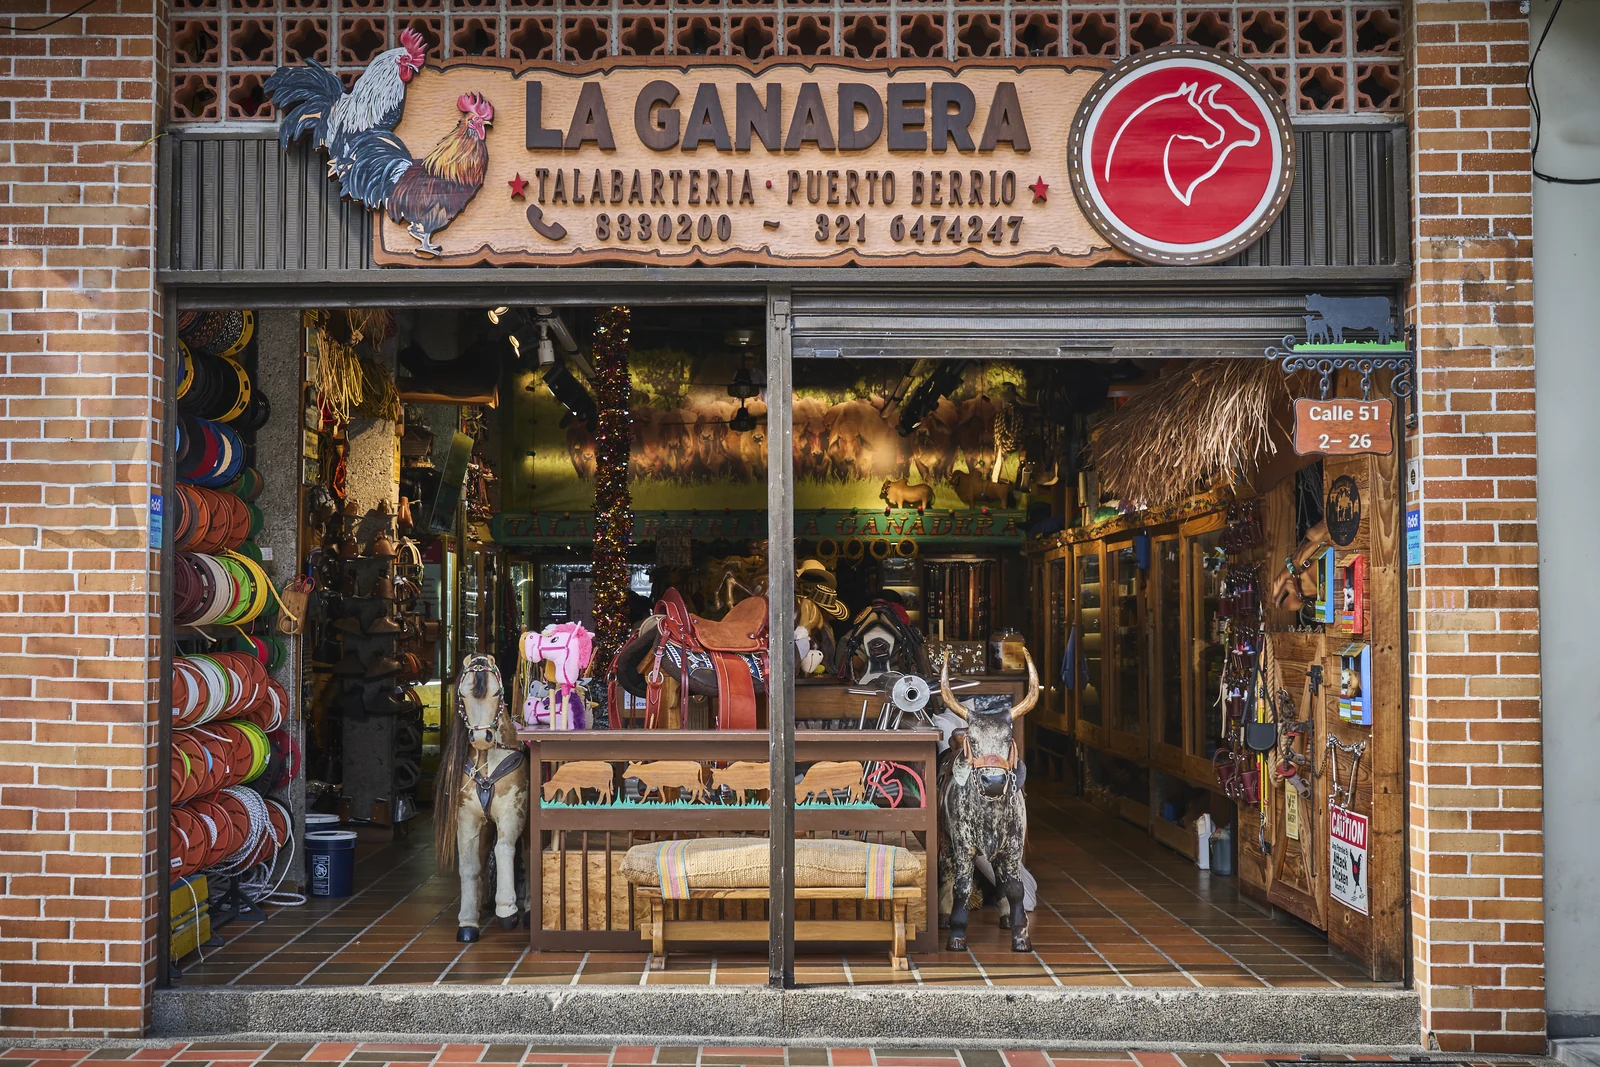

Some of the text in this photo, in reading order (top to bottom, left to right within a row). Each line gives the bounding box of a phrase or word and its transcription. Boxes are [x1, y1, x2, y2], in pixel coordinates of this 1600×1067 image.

[526, 80, 1031, 151] LA GANADERA
[535, 168, 1016, 206] TALABARTERIA PUERTO BERRIO
[595, 212, 732, 242] 8330200
[814, 213, 866, 243] 321
[889, 214, 1024, 244] 6474247
[1309, 405, 1379, 421] Calle 51
[1348, 433, 1372, 449] 26
[836, 516, 1019, 536] GANADERA
[1331, 811, 1364, 846] CAUTION
[1332, 864, 1349, 887] Chicken
